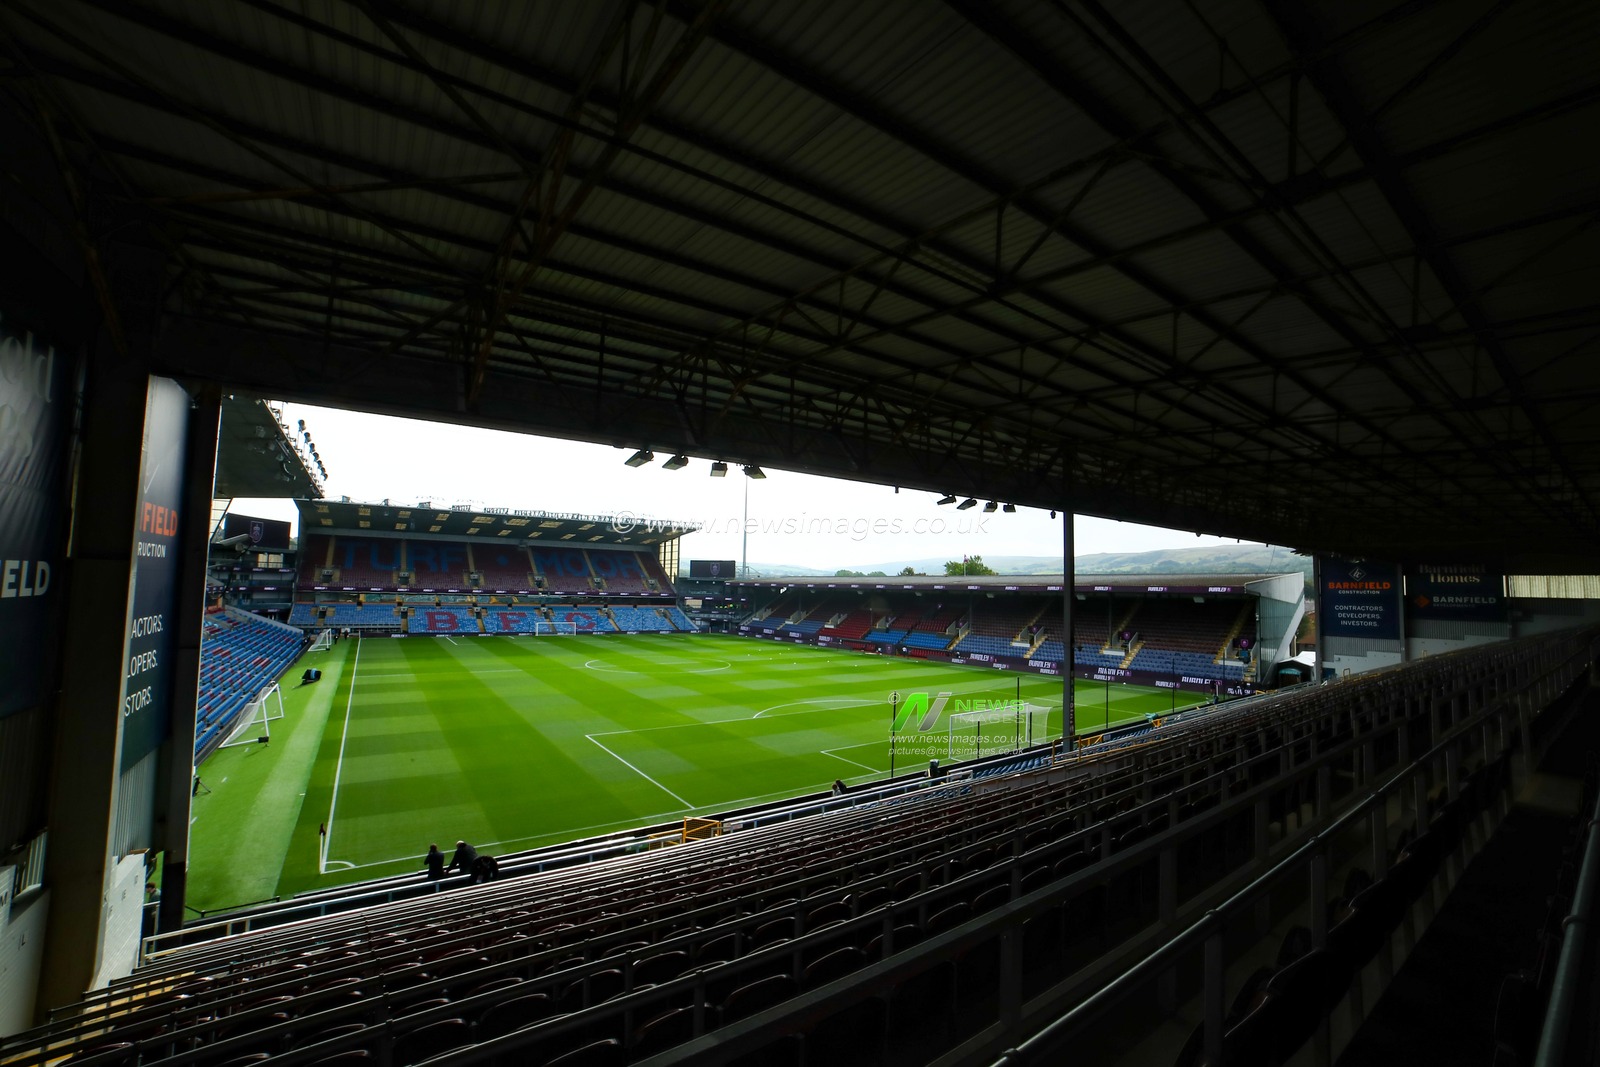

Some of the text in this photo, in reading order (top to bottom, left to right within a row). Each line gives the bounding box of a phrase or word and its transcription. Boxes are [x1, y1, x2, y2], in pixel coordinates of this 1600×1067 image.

[139, 501, 178, 537] FIELD
[137, 541, 167, 558] RUCTION
[335, 540, 644, 579] TURF MOOR
[0, 560, 51, 598] ELD
[1328, 581, 1392, 590] BARNFIELD
[1430, 573, 1481, 584] Homes
[1334, 604, 1384, 612] CONTRACTORS.
[1432, 596, 1497, 604] BARNFIELD
[131, 614, 163, 639] ACTORS.
[425, 611, 596, 632] B F C
[128, 649, 158, 678] OPERS.
[124, 686, 153, 717] STORS.
